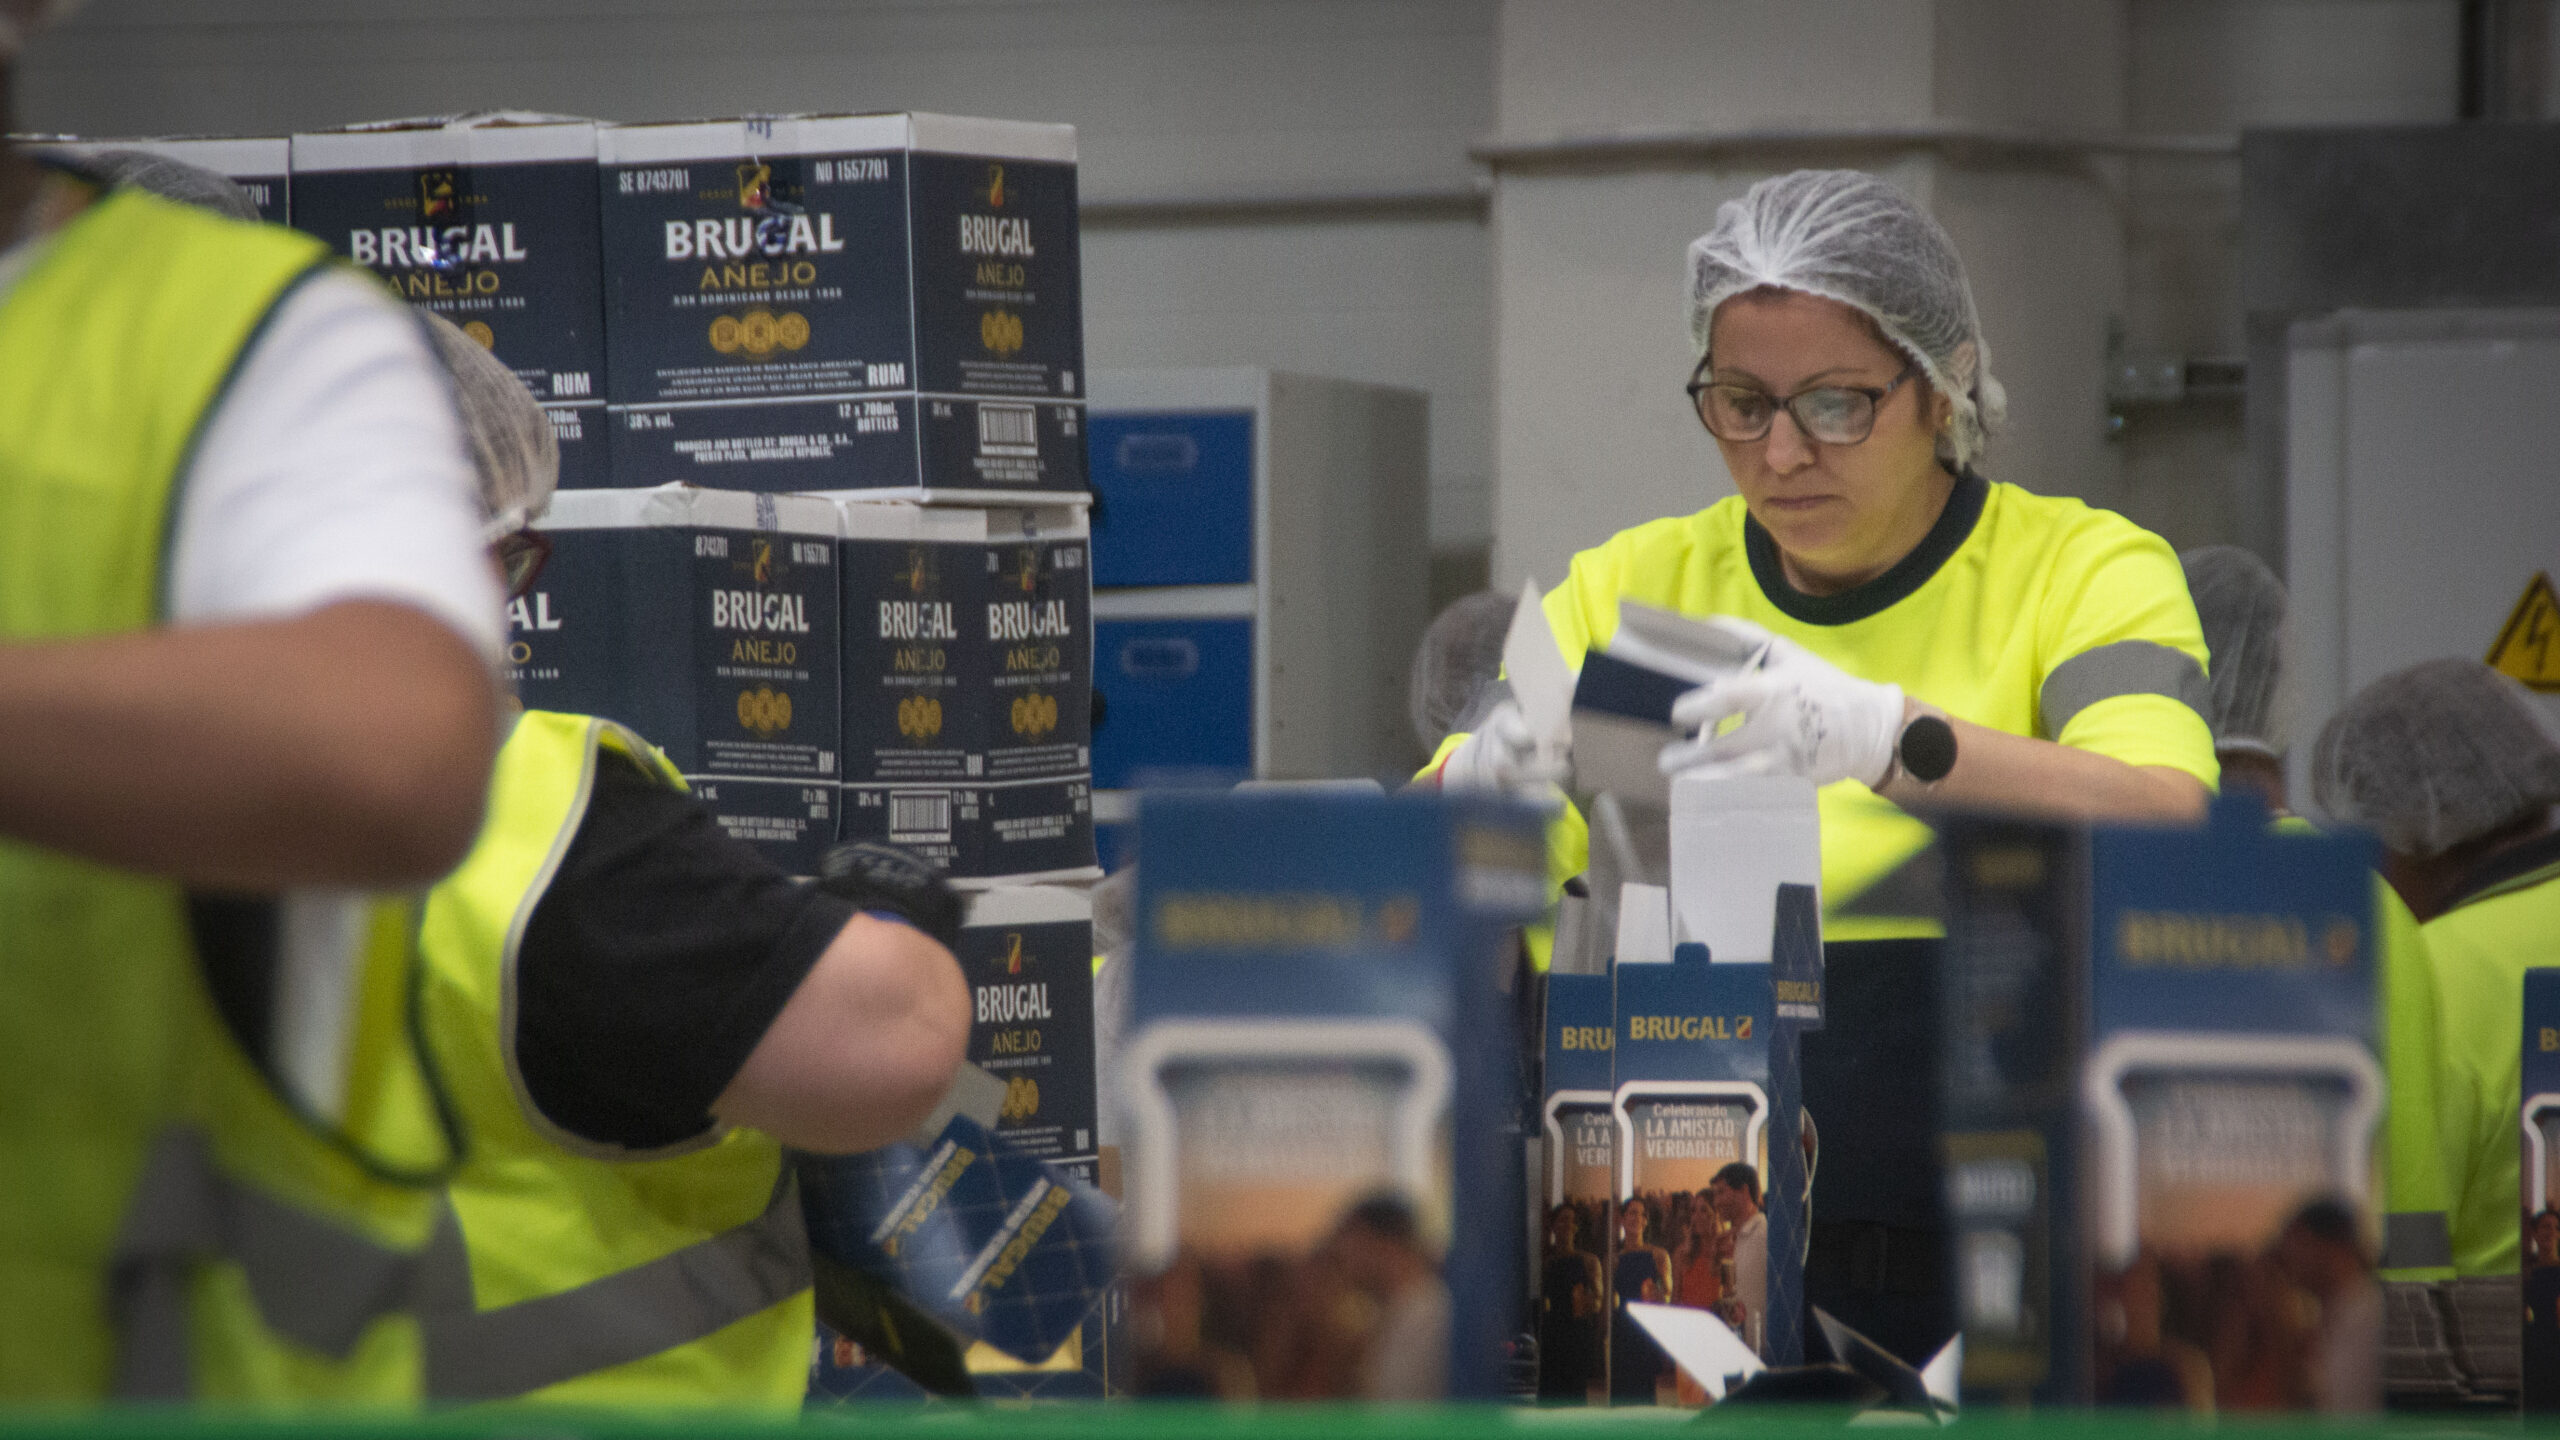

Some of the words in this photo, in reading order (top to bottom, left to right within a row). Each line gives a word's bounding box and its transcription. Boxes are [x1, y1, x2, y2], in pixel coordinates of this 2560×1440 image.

[619, 171, 634, 193] SE
[637, 169, 689, 191] 8743701
[815, 161, 833, 183] NO
[837, 158, 889, 182] 1557701
[351, 222, 527, 267] BRUGAL
[666, 212, 844, 260] BRUGAL
[960, 214, 1034, 256] BRUGAL
[388, 269, 499, 297] AÑEJO
[701, 258, 816, 289] AÑEJO
[700, 290, 770, 305] DOMINICANO
[776, 287, 810, 301] DESDE
[553, 371, 591, 395] RUM
[867, 362, 905, 387] RUM
[838, 402, 851, 418] 12
[857, 415, 899, 433] BOTTLES
[713, 589, 810, 632] BRUGAL
[880, 600, 957, 640] BRUGAL
[988, 599, 1070, 640] BRUGAL
[977, 982, 1051, 1024] BRUGAL
[1562, 1026, 1614, 1050] BRU
[1630, 1015, 1731, 1041] BRUGAL
[992, 1028, 1041, 1054] AÑEJO
[1653, 1102, 1727, 1118] Celebrando
[1576, 1126, 1597, 1146] LA
[1645, 1118, 1666, 1138] LA
[1670, 1118, 1735, 1138] AMISTAD
[1646, 1138, 1735, 1159] VERDADERA
